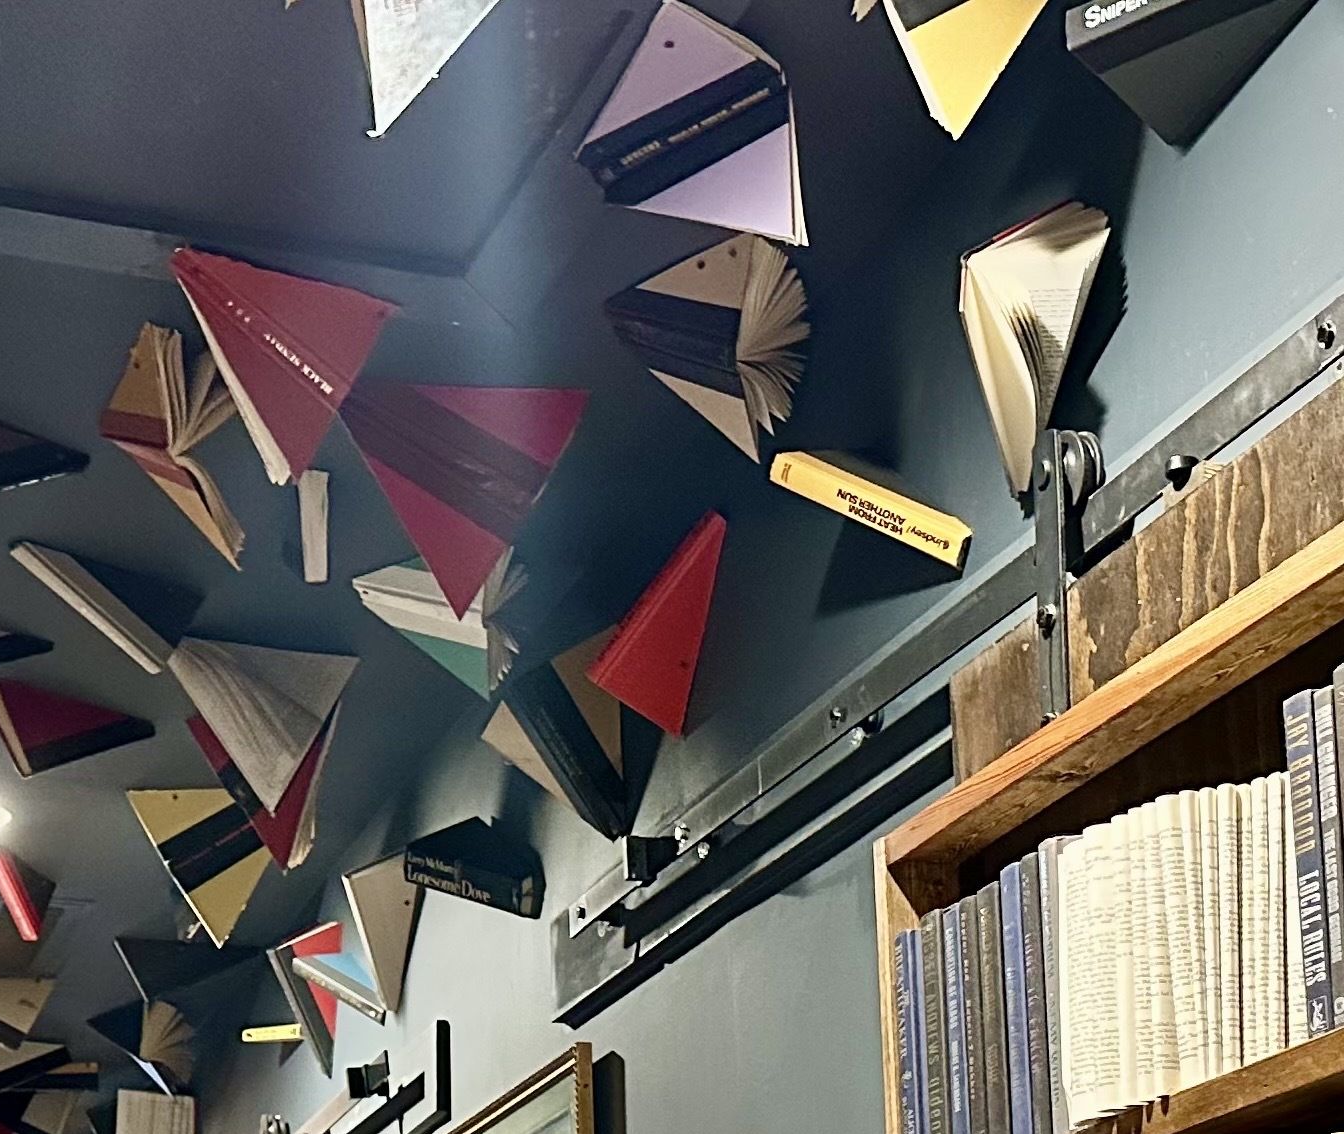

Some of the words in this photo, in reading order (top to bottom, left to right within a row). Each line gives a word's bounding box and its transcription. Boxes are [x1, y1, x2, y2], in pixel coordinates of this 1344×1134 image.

[263, 333, 301, 366] SUNDAY
[301, 364, 334, 395] BLACK
[836, 488, 859, 505] SUN
[848, 504, 877, 524] FROM
[858, 498, 906, 525] ANOTHER
[876, 517, 903, 536] HEAT
[1285, 711, 1311, 748] JAY
[1314, 703, 1333, 744] BILL
[1317, 744, 1339, 823] GRANGER
[406, 862, 462, 895] Lonesome
[460, 879, 492, 903] Dove
[1297, 868, 1323, 931] LOCAL
[1303, 926, 1328, 988] RULES
[925, 996, 940, 1067] ANDREWS
